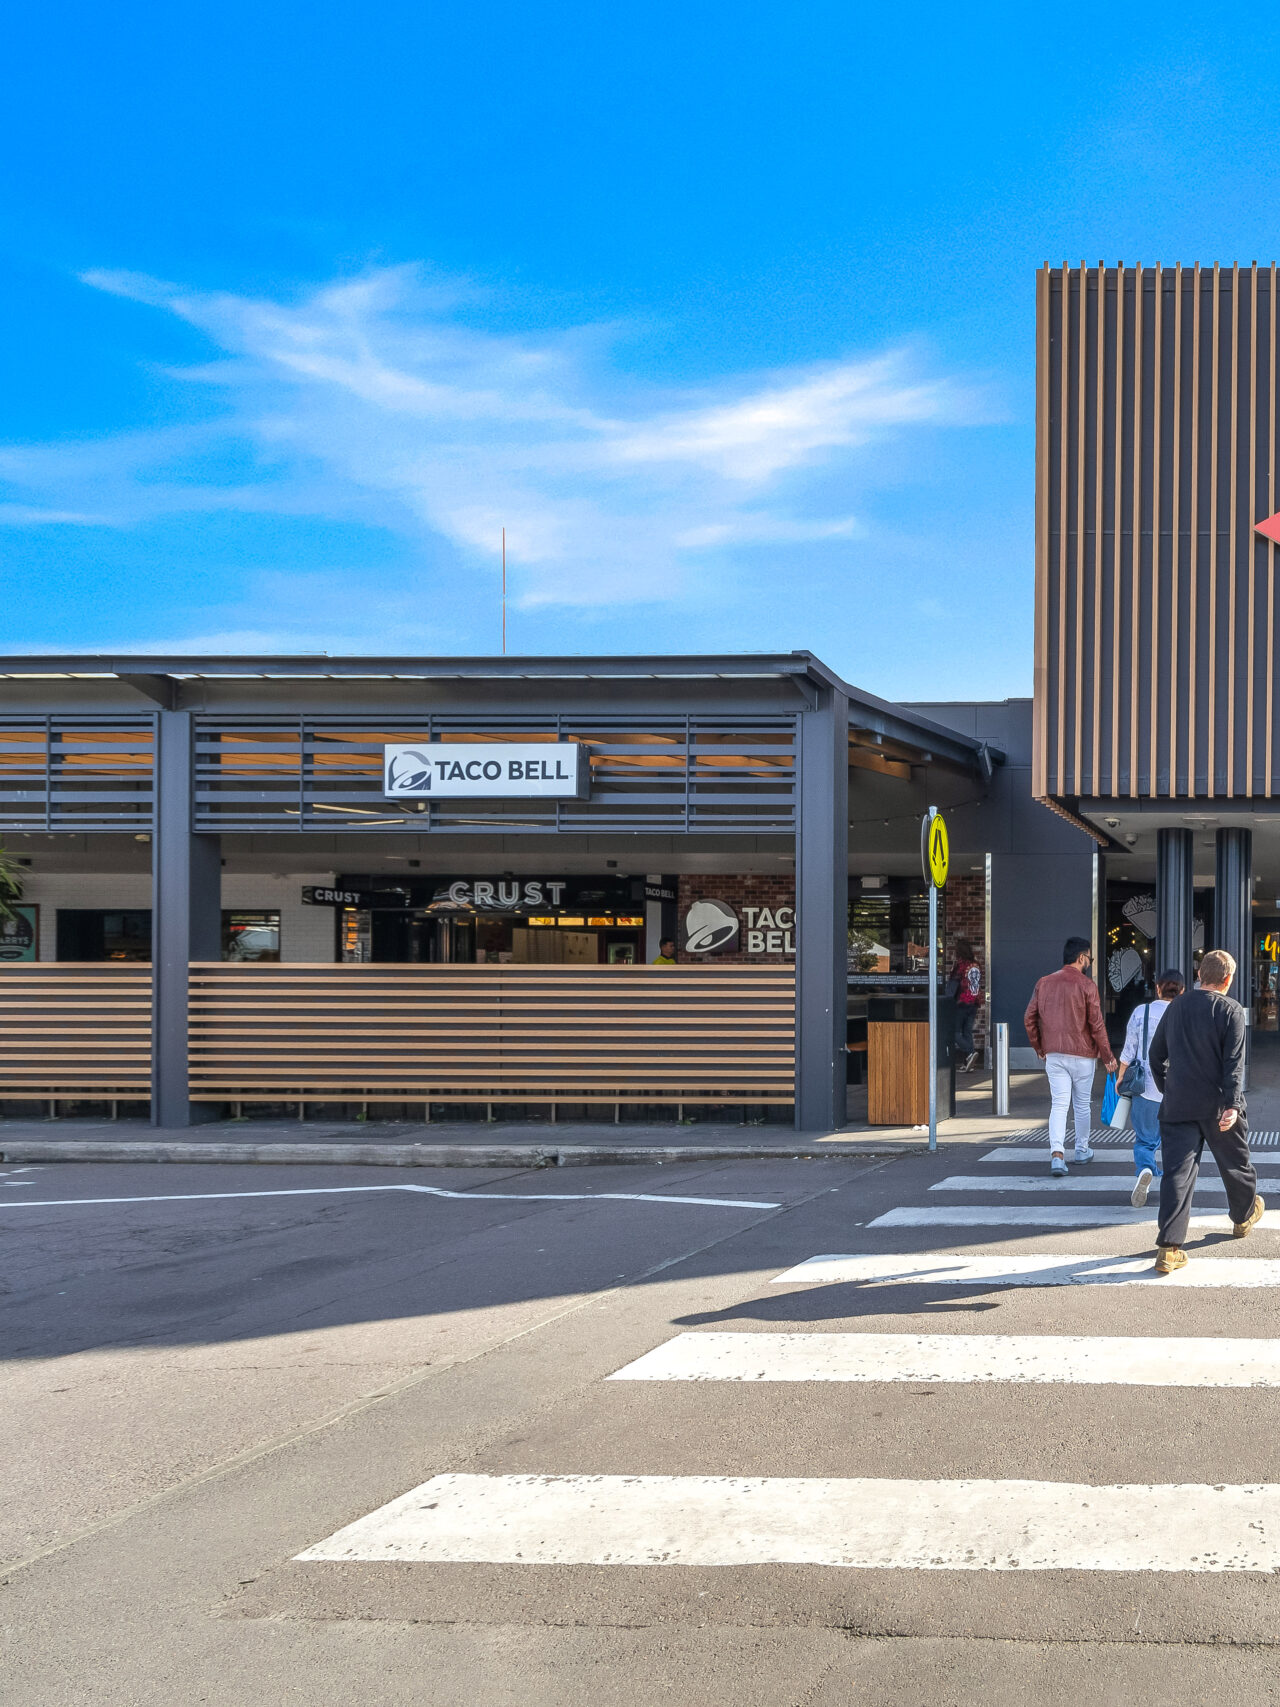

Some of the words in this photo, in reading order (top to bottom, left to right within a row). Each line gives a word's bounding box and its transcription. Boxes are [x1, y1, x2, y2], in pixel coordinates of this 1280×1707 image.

[435, 760, 502, 781] TACO
[508, 760, 569, 780] BELL
[314, 889, 361, 904] CRUST
[449, 881, 566, 905] CRUST
[644, 887, 660, 897] TACO
[660, 889, 676, 899] BELL
[741, 907, 797, 929] TAC
[747, 931, 797, 953] BEL
